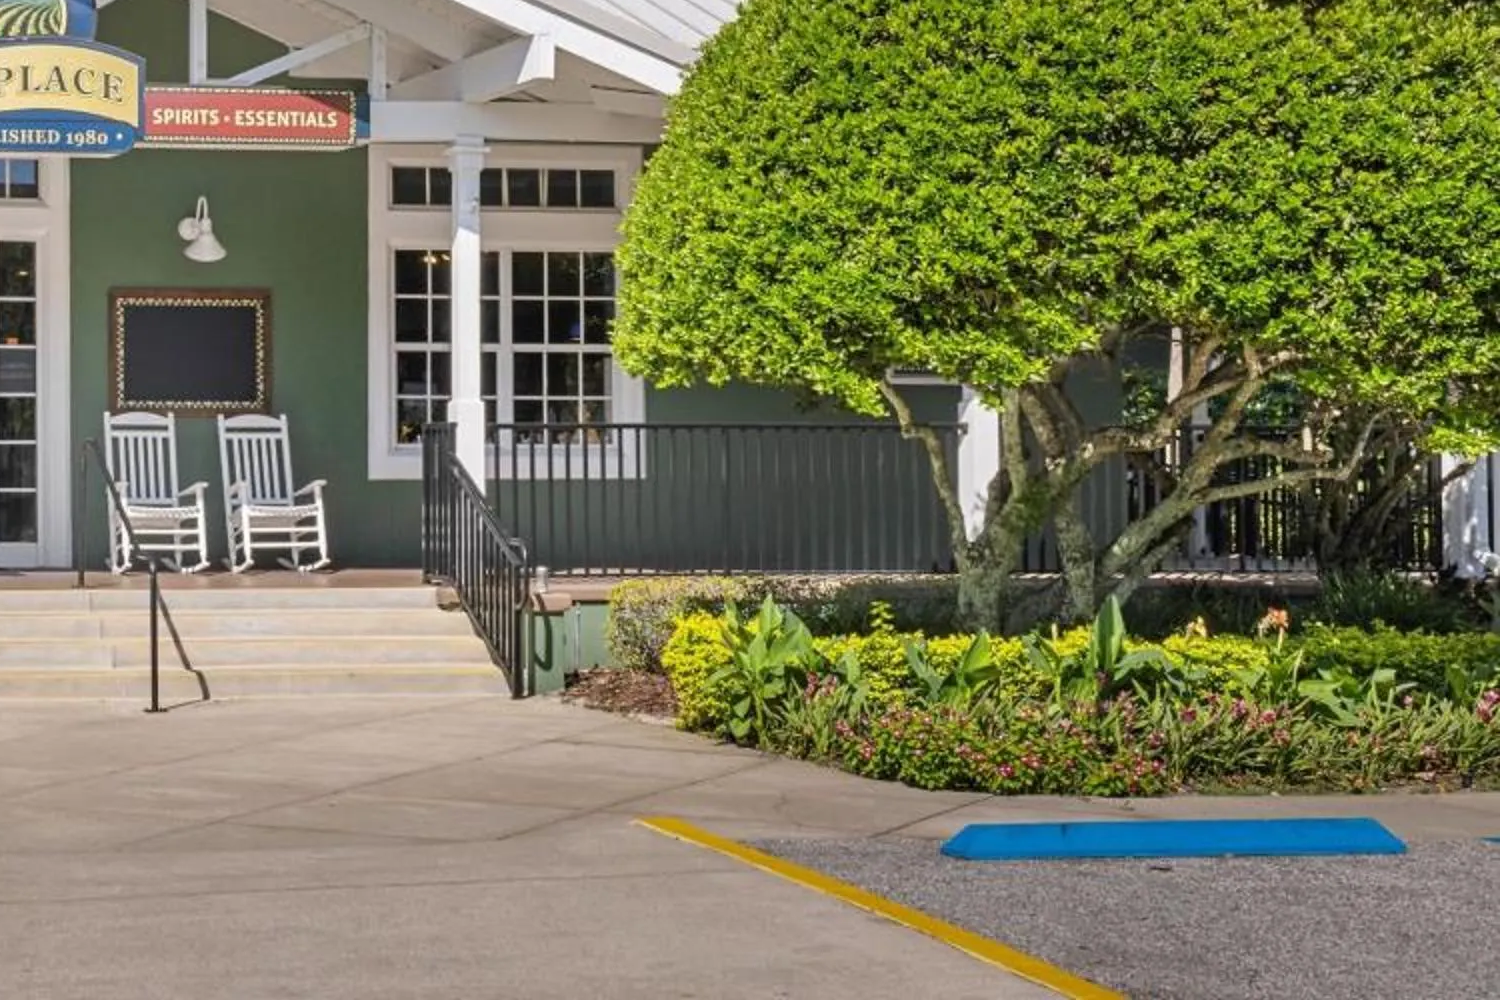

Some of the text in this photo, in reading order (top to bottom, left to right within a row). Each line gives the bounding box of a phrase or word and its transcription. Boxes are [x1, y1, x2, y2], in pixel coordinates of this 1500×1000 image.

[152, 107, 338, 128] SPIRITS ESSENTIALS
[66, 129, 109, 147] 1980
